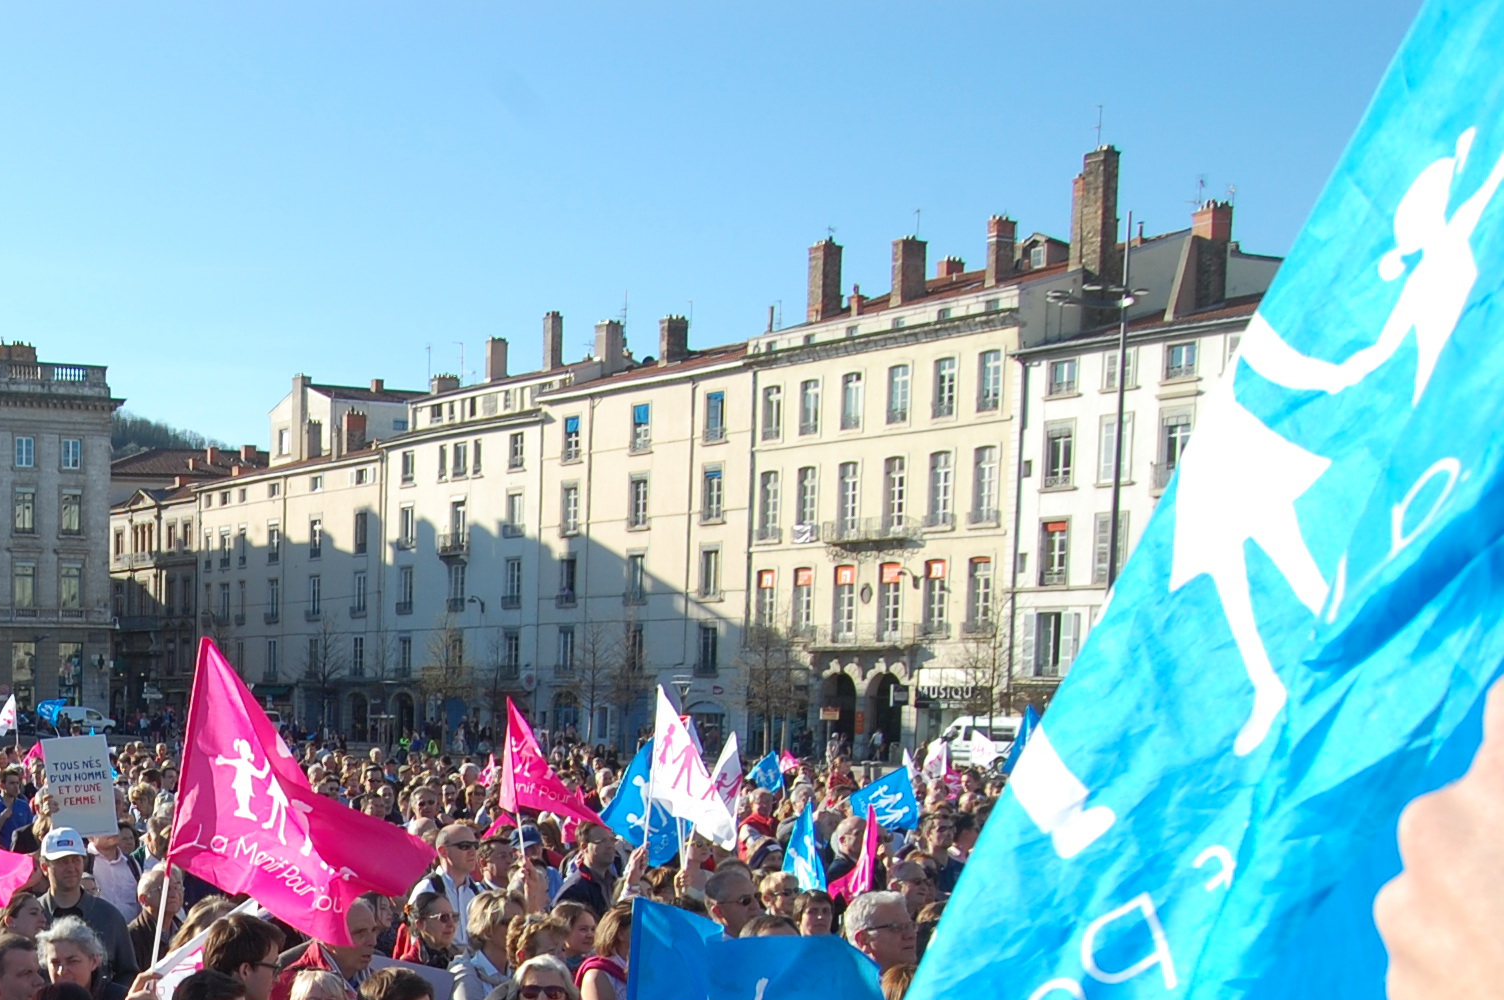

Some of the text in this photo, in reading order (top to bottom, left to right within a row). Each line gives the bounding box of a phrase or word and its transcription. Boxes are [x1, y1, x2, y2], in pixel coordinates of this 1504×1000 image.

[53, 756, 102, 771] TOUS NÉS
[50, 770, 108, 784] D'UN HOMME
[58, 782, 102, 794] ET D'UNE
[515, 782, 535, 794] nif
[64, 795, 96, 806] FEMME
[234, 836, 289, 879] Manif
[278, 863, 315, 896] Pour
